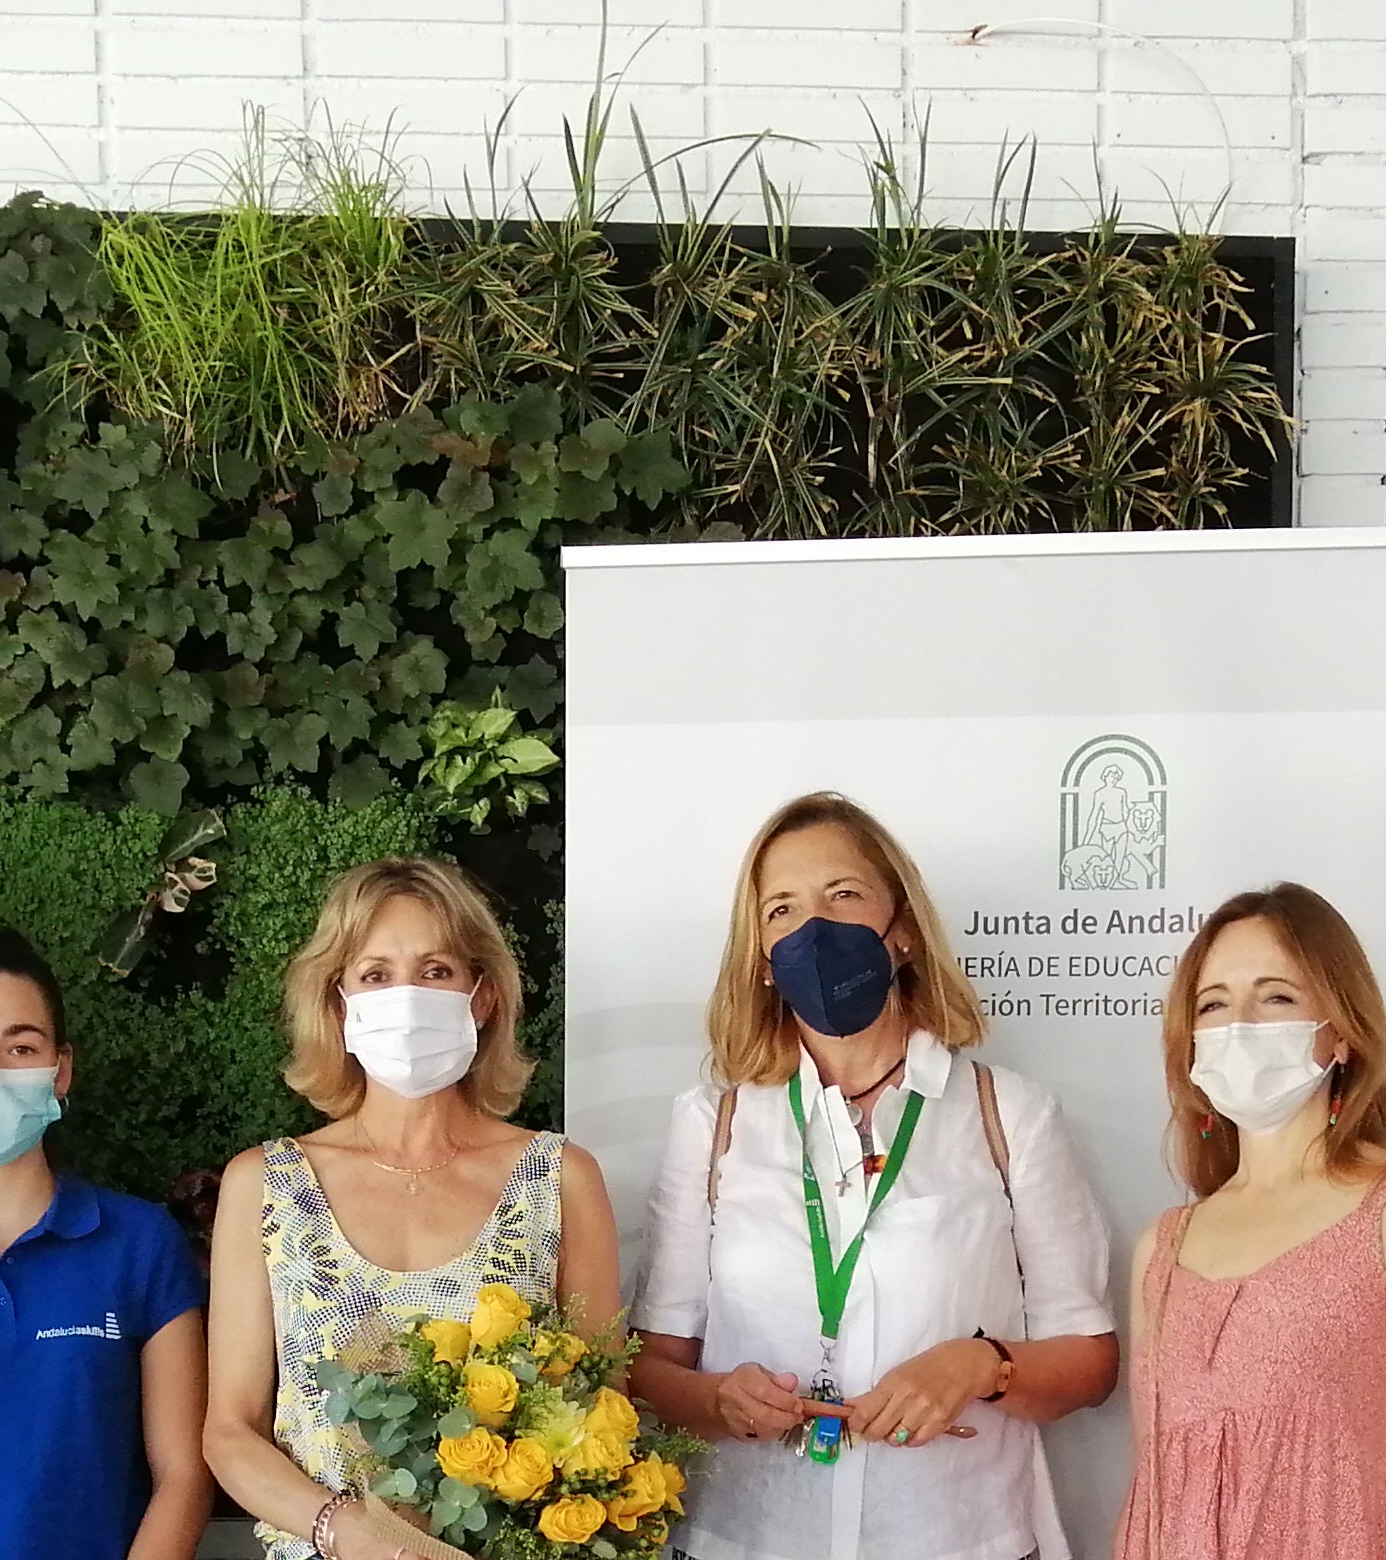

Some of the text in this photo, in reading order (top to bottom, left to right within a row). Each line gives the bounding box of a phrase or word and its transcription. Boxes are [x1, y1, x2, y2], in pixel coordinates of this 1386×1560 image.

[964, 910, 1051, 936] Junta
[1061, 908, 1098, 935] de
[1028, 956, 1060, 978] DE
